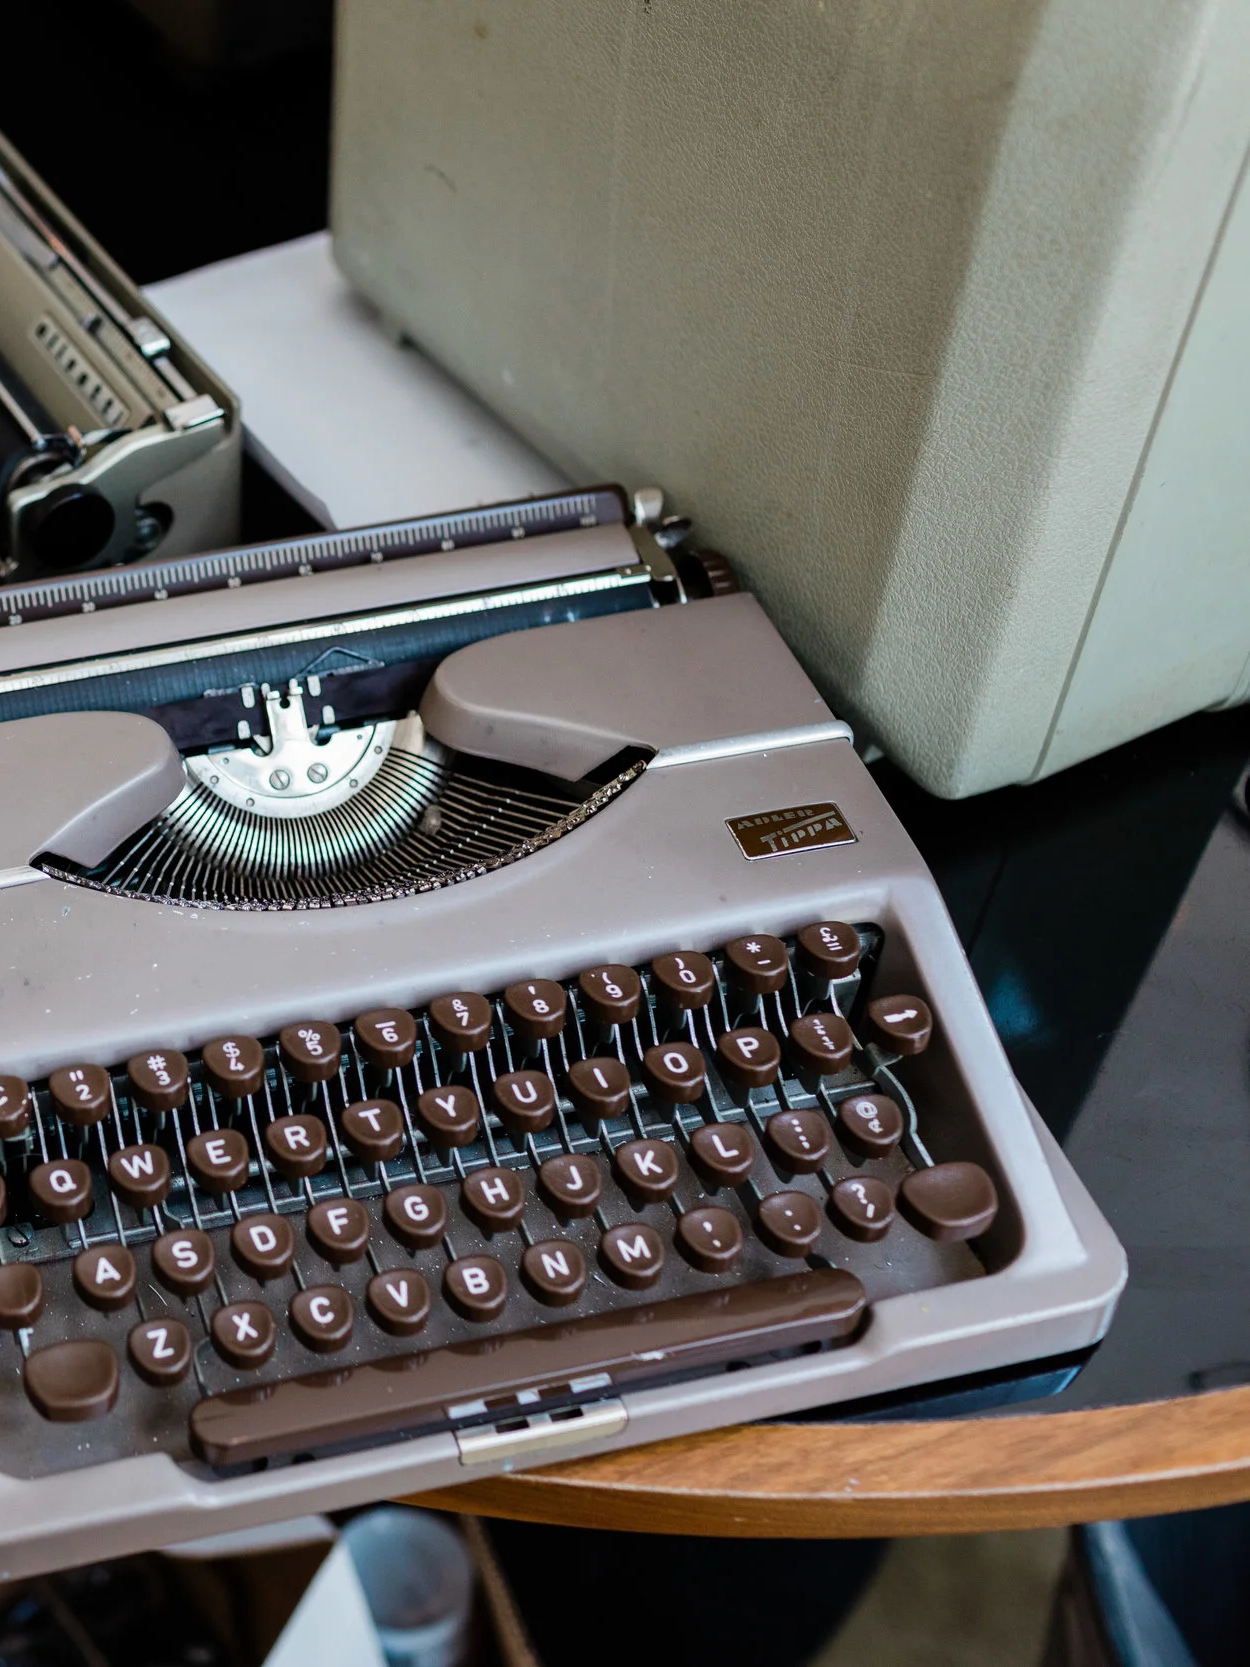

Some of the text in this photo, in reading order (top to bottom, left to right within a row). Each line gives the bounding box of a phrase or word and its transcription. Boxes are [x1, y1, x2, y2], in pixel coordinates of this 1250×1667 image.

[737, 808, 815, 830] ADLER
[605, 984, 623, 998] 9
[452, 998, 468, 1013] &
[532, 999, 550, 1014] 8
[455, 1012, 470, 1026] 7
[298, 1029, 321, 1043] %
[382, 1028, 398, 1043] 6
[223, 1042, 240, 1058] $
[307, 1042, 323, 1056] 5
[736, 1037, 759, 1058] P
[147, 1055, 166, 1071] #
[229, 1058, 245, 1071] 4
[664, 1053, 688, 1073] O
[157, 1071, 171, 1086] 3
[593, 1068, 608, 1088] I
[76, 1084, 92, 1100] 2
[512, 1081, 537, 1103] U
[435, 1095, 456, 1117] Y
[855, 1101, 878, 1119] @
[358, 1108, 380, 1131] T
[284, 1126, 310, 1149] R
[712, 1135, 739, 1157] L
[206, 1139, 231, 1164] E
[634, 1150, 662, 1175] K
[121, 1151, 153, 1178] W
[50, 1170, 76, 1192] Q
[567, 1166, 582, 1190] J
[480, 1178, 509, 1204] H
[850, 1184, 868, 1205] ?
[404, 1196, 429, 1220] G
[327, 1208, 348, 1234] F
[249, 1225, 276, 1251] D
[617, 1235, 651, 1262] M
[172, 1241, 198, 1268] S
[541, 1251, 569, 1278] N
[96, 1257, 120, 1283] A
[462, 1267, 489, 1294] B
[386, 1281, 407, 1307] V
[310, 1297, 334, 1323] C
[232, 1313, 258, 1341] X
[147, 1328, 174, 1358] Z
